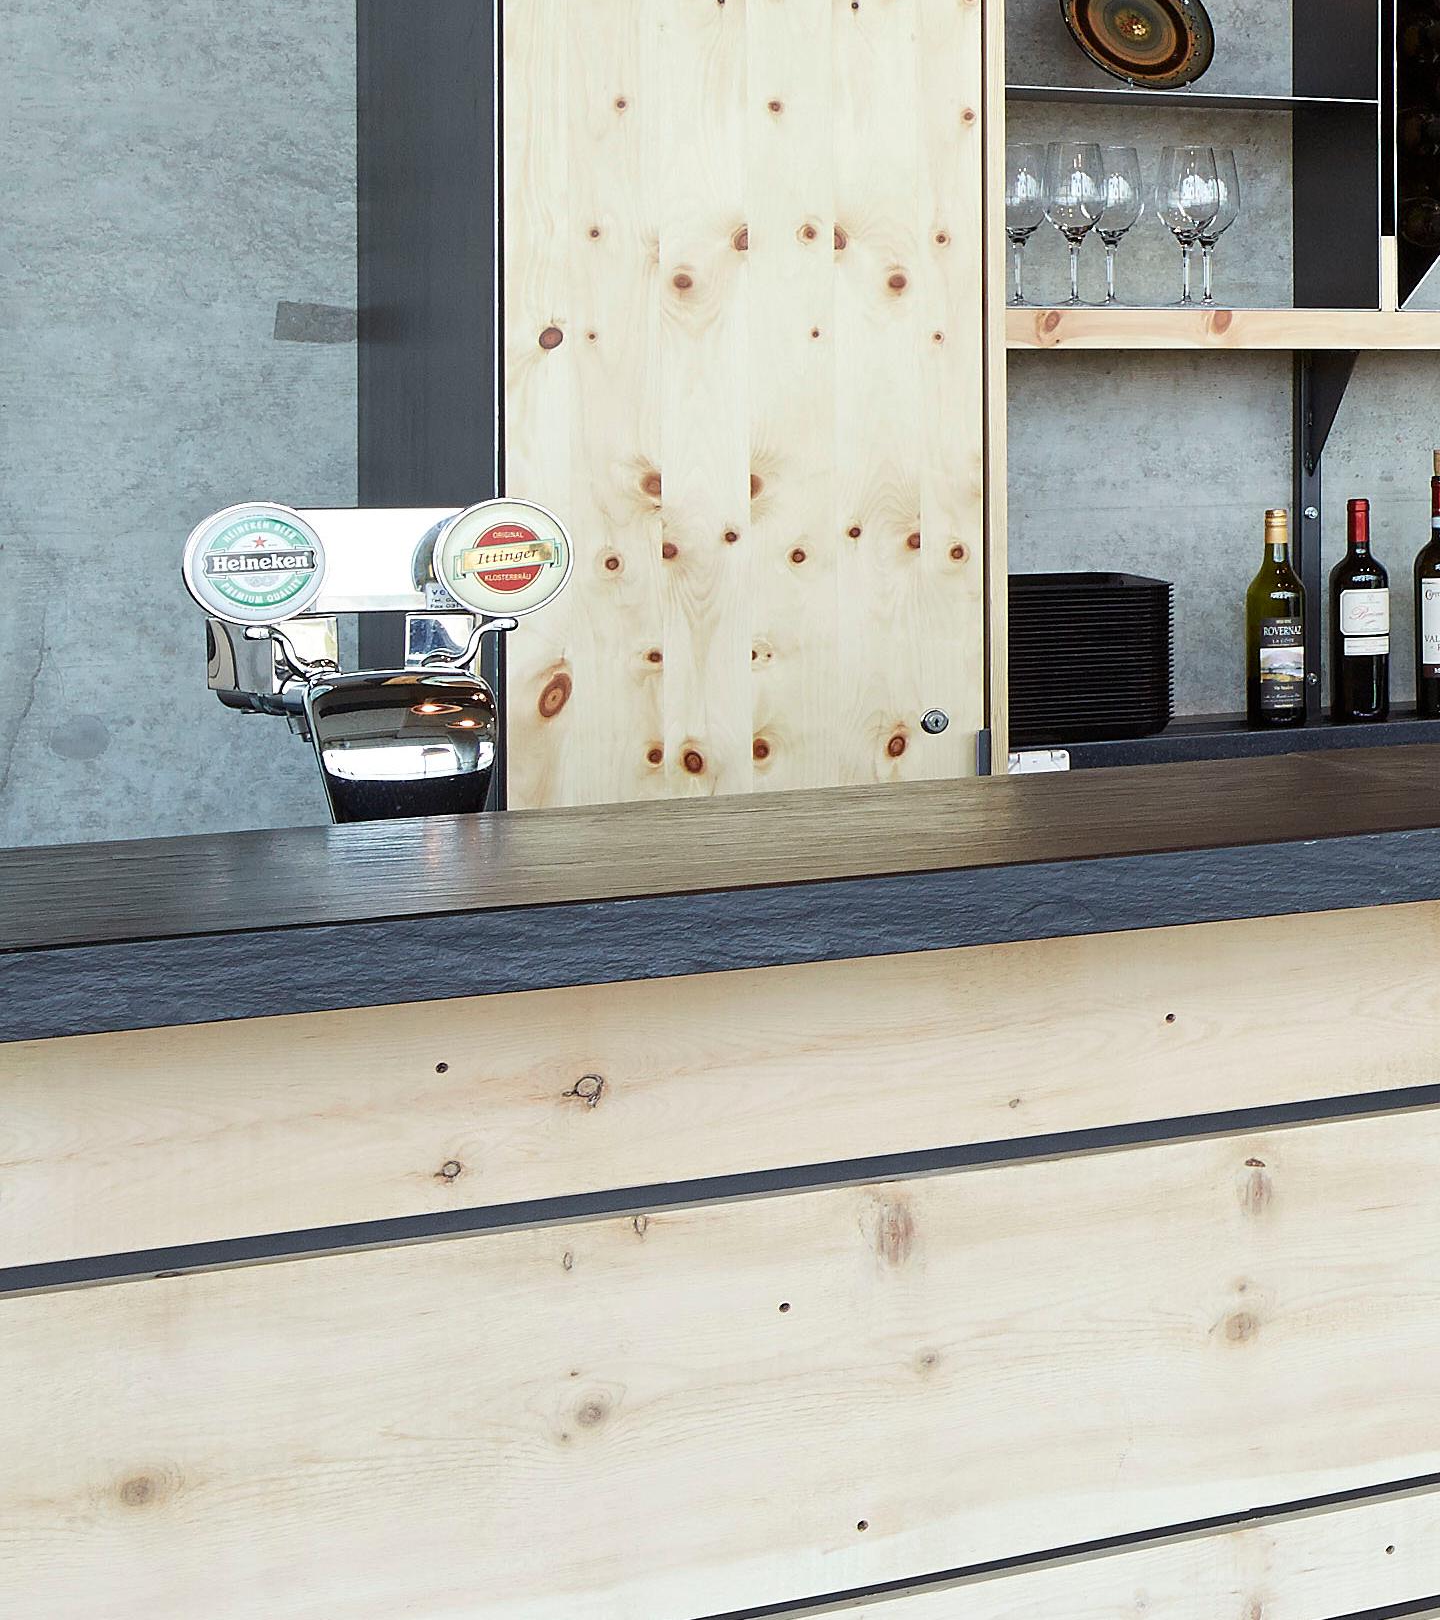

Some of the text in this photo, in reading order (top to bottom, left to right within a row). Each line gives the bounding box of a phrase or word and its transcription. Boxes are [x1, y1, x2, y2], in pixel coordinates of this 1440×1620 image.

[224, 521, 296, 543] HEINEKEN BEER
[493, 531, 523, 539] ORIGINAL
[212, 553, 308, 572] Heineken
[477, 548, 540, 565] Ittinger
[484, 572, 531, 581] KLOSTERBRÄU
[221, 578, 300, 604] PREMIUM QUALITY
